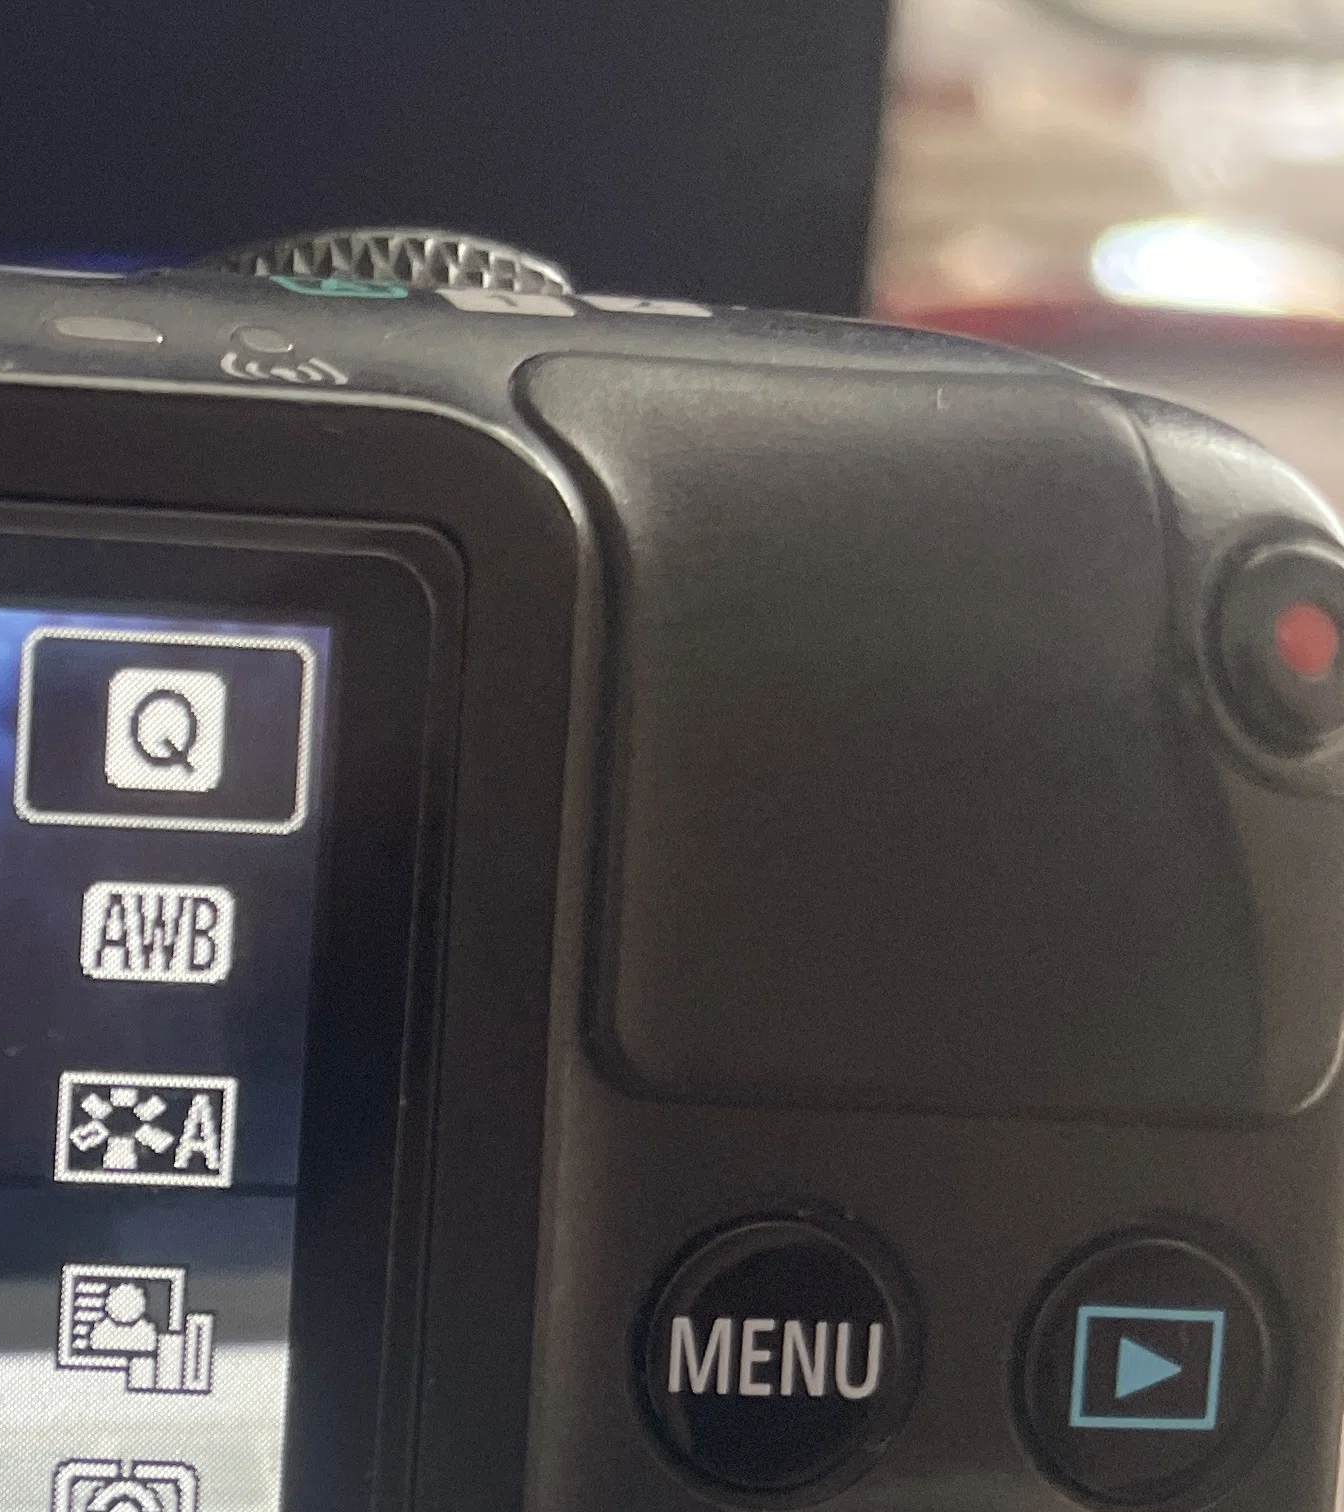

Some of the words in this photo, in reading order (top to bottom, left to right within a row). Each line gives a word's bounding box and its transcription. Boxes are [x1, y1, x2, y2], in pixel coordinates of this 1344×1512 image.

[130, 688, 198, 773] Q
[95, 892, 220, 971] AWB
[667, 1315, 884, 1400] MENU
